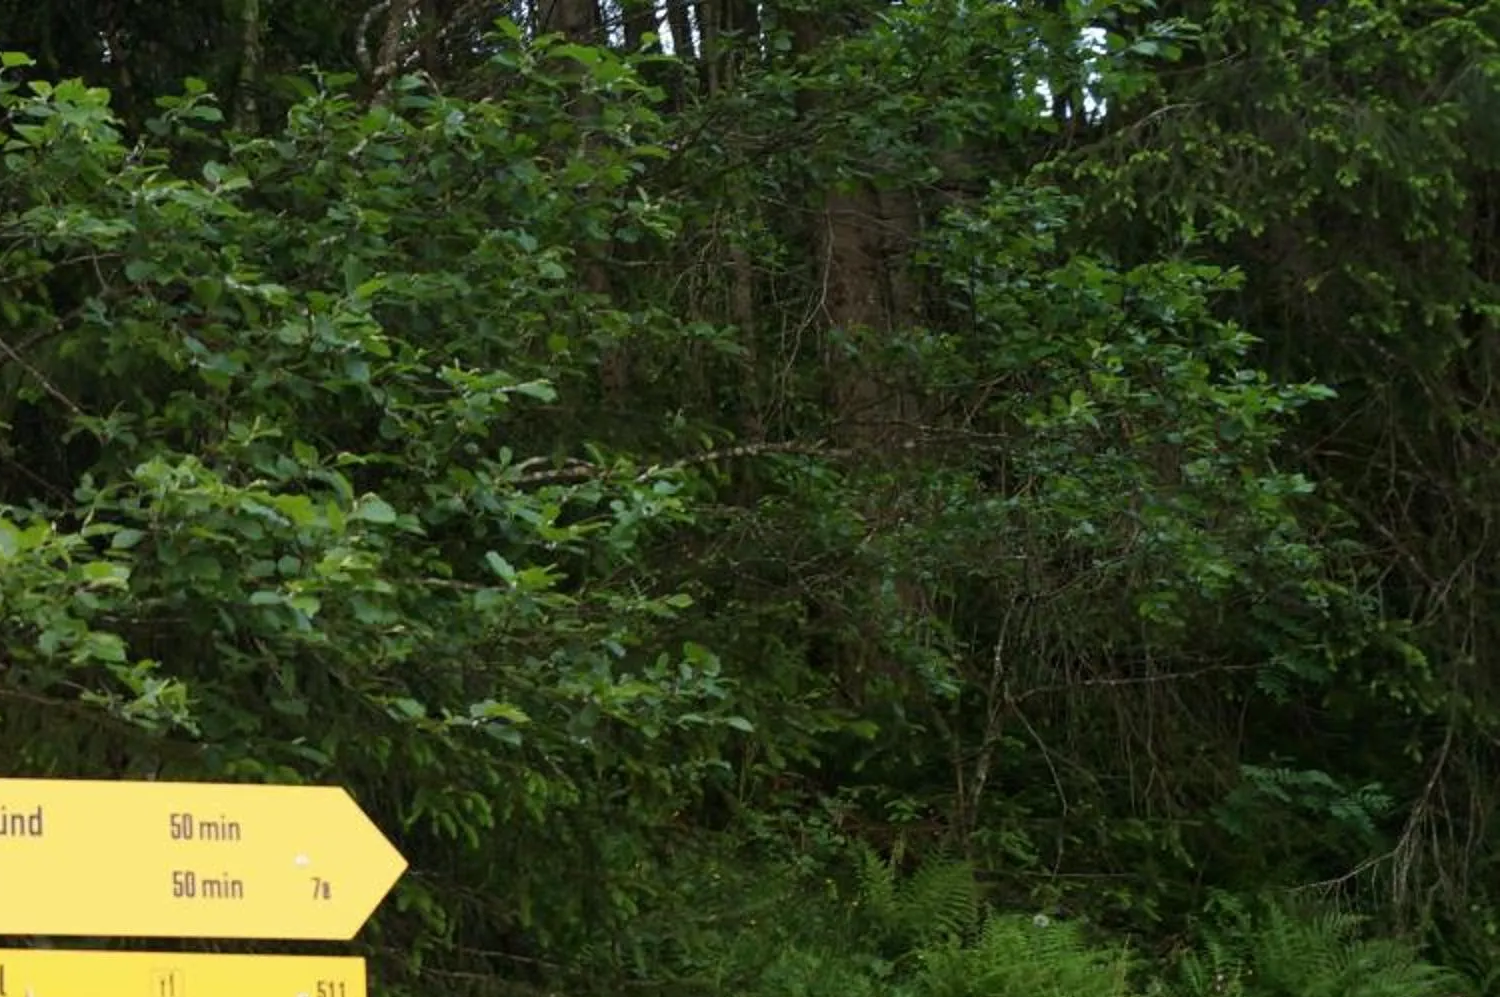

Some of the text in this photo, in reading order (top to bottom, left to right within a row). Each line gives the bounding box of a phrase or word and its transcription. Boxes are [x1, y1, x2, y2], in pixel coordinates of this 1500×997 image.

[169, 813, 241, 841] 50 min
[172, 871, 244, 899] 50 min
